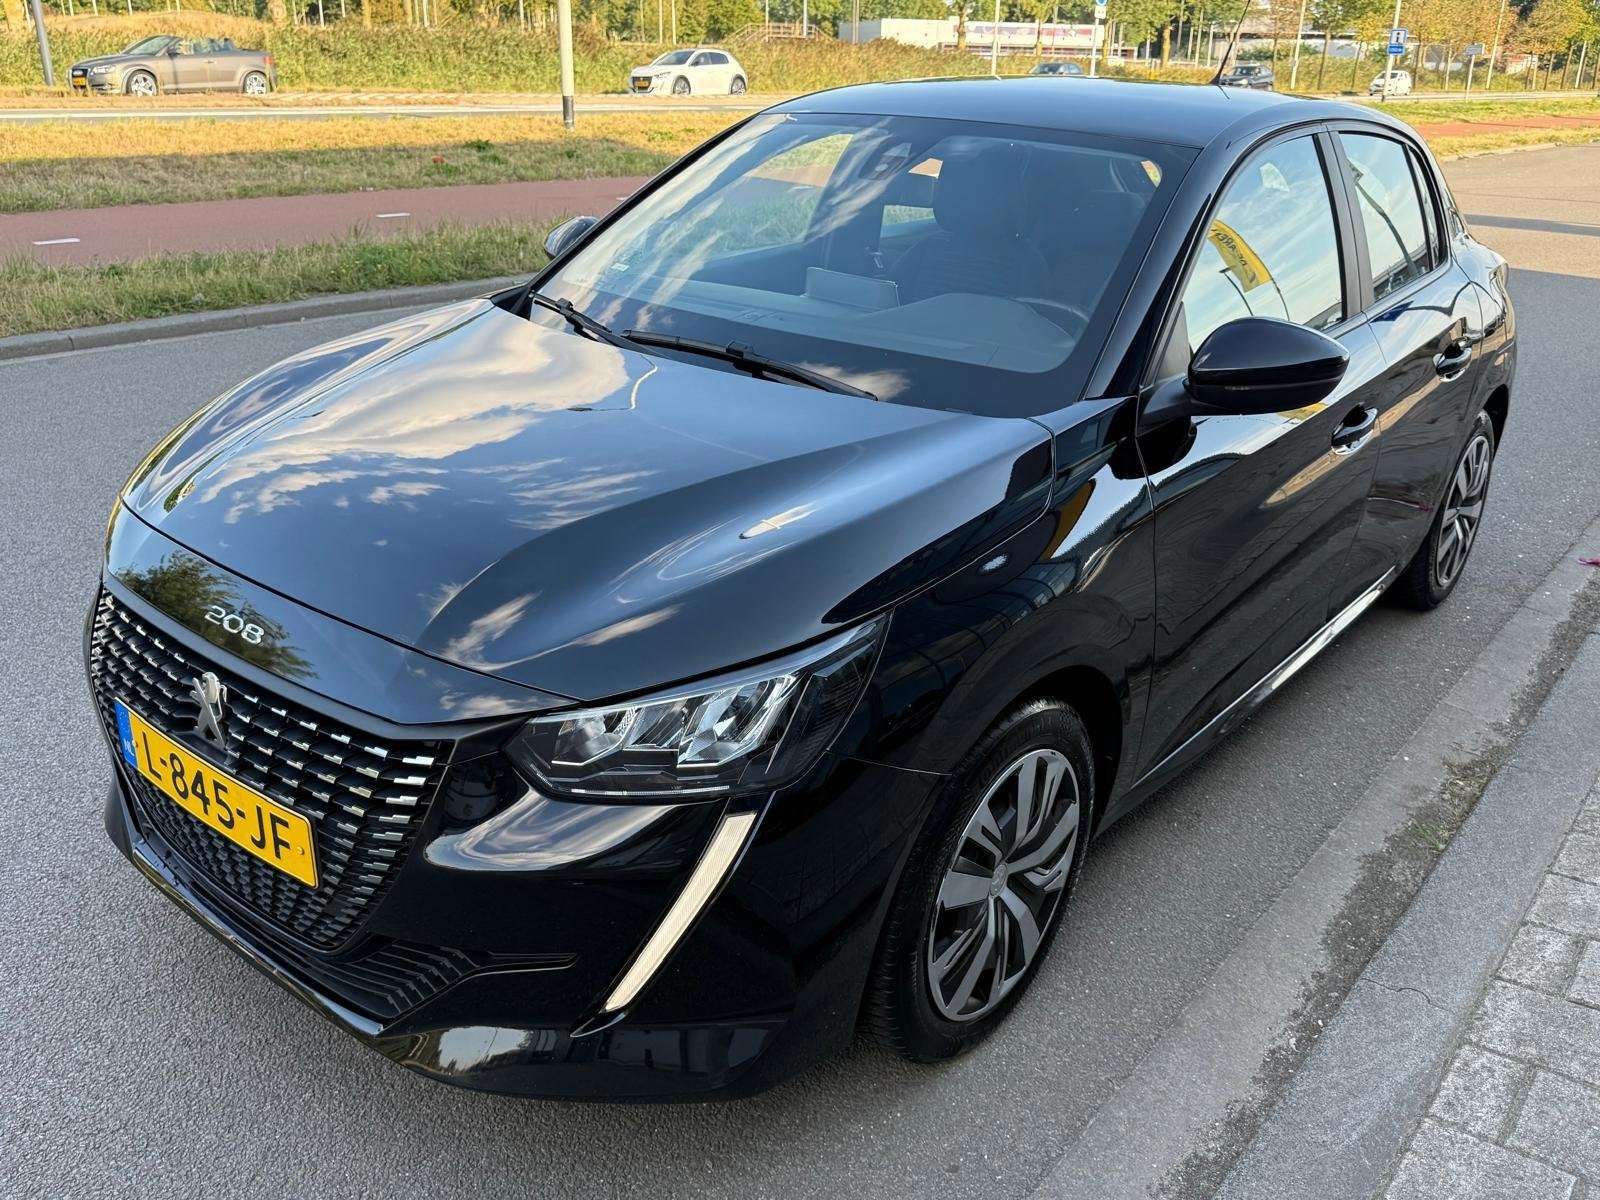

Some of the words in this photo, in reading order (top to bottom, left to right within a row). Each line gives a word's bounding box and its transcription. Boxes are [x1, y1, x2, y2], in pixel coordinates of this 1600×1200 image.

[204, 605, 265, 645] 208
[123, 738, 136, 757] NL
[142, 731, 291, 860] L-845-JF
